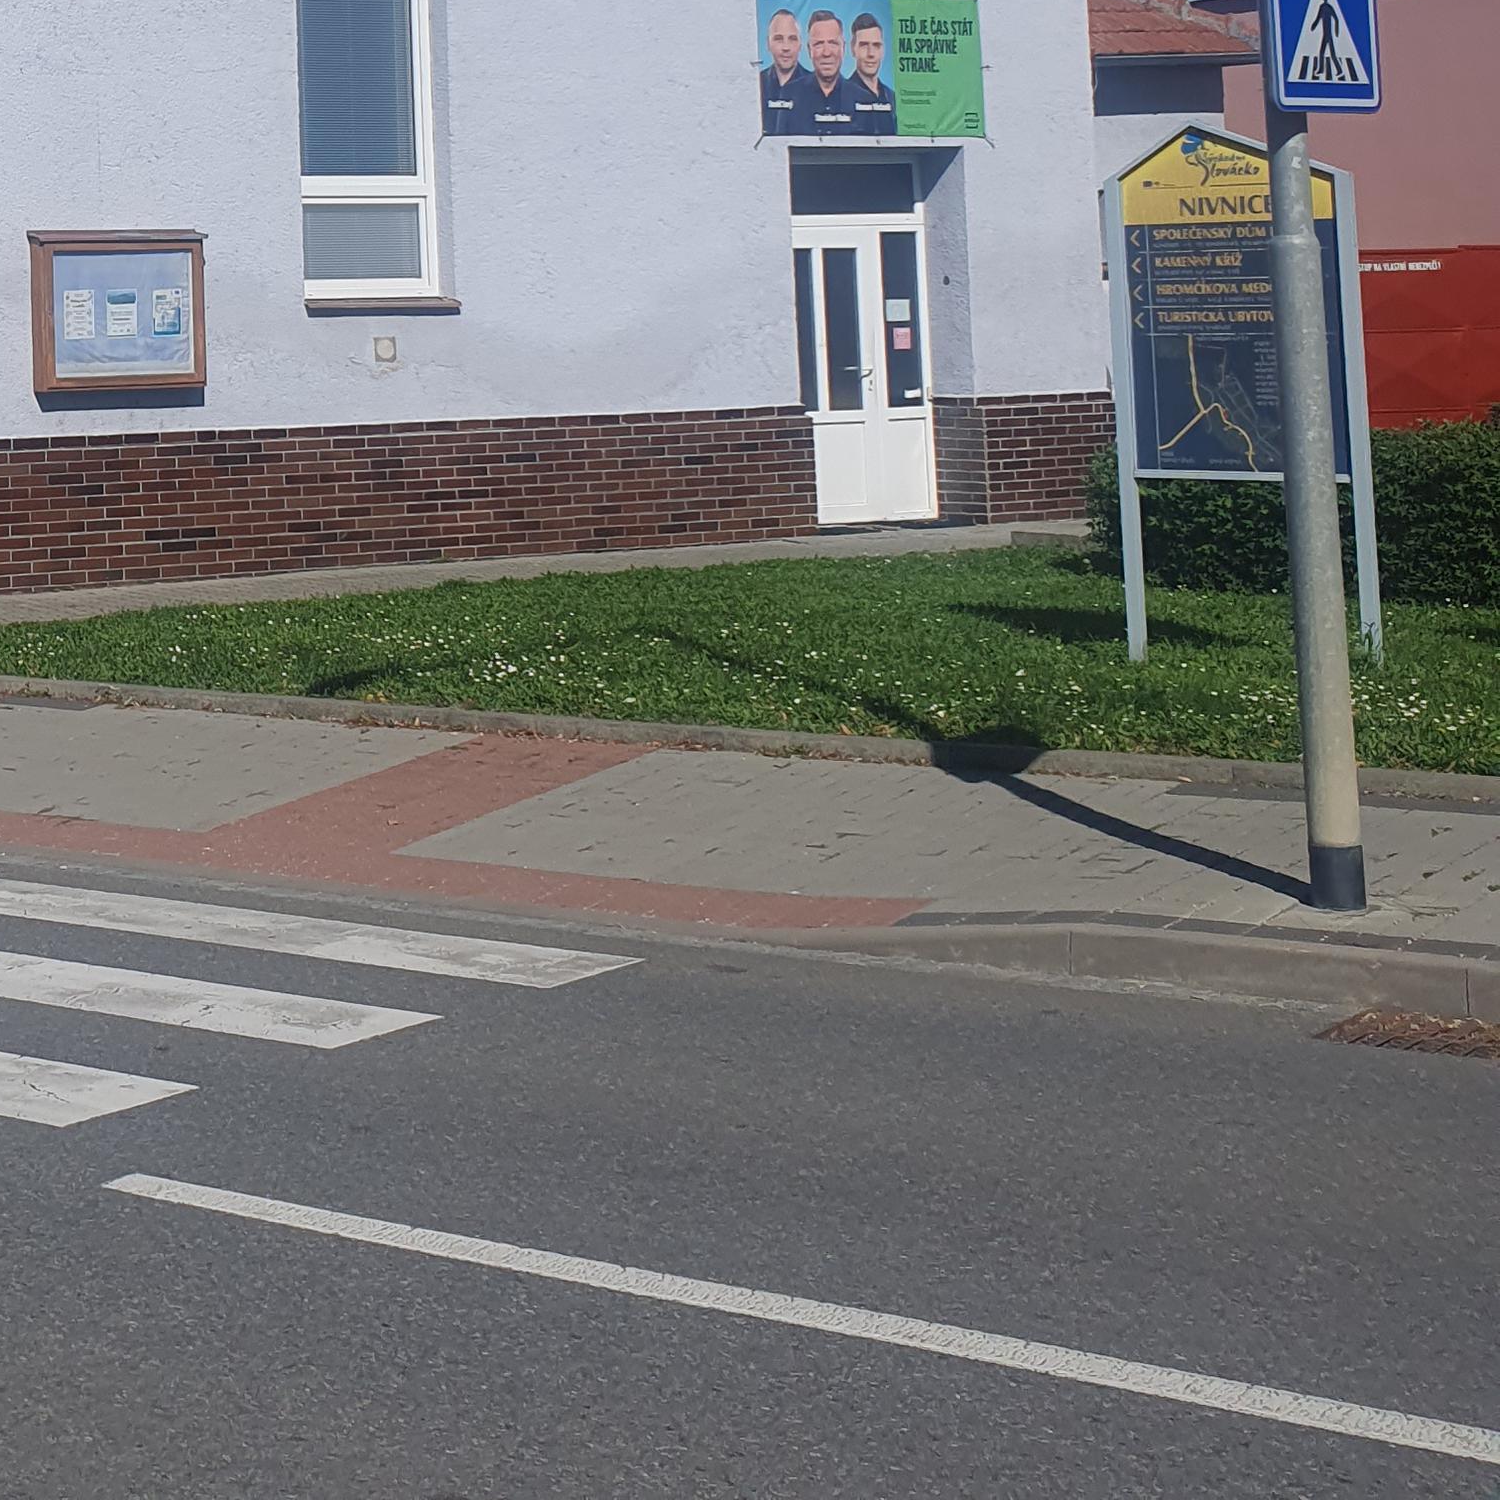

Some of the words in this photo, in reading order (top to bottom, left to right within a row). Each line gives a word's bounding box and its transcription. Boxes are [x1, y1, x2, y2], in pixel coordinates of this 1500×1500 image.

[898, 16, 916, 34] TEĎ
[918, 19, 929, 35] JE
[930, 17, 949, 36] ČAS
[950, 17, 973, 36] STÁT
[898, 37, 912, 53] NA
[1153, 225, 1232, 240] SPOLEČENSKÝ
[1236, 224, 1266, 238] DŮM
[1157, 308, 1226, 323] TURISTICKÁ
